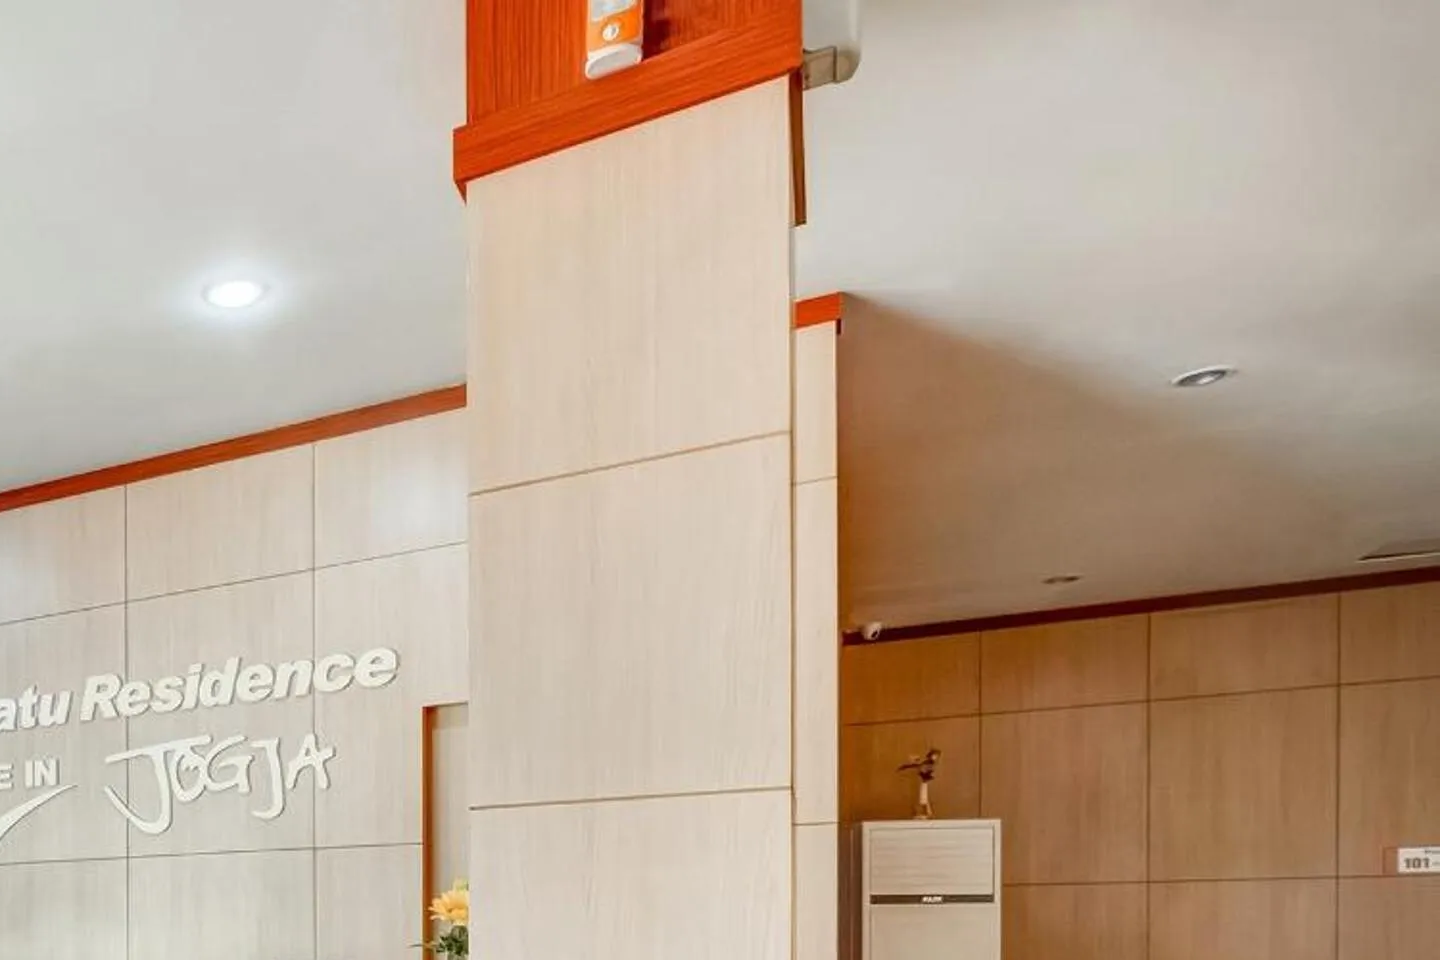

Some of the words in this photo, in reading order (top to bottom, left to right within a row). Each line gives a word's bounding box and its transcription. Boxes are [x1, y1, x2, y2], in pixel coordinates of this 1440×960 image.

[80, 648, 398, 721] Residence
[25, 758, 59, 788] IN
[105, 733, 336, 834] JOGJA
